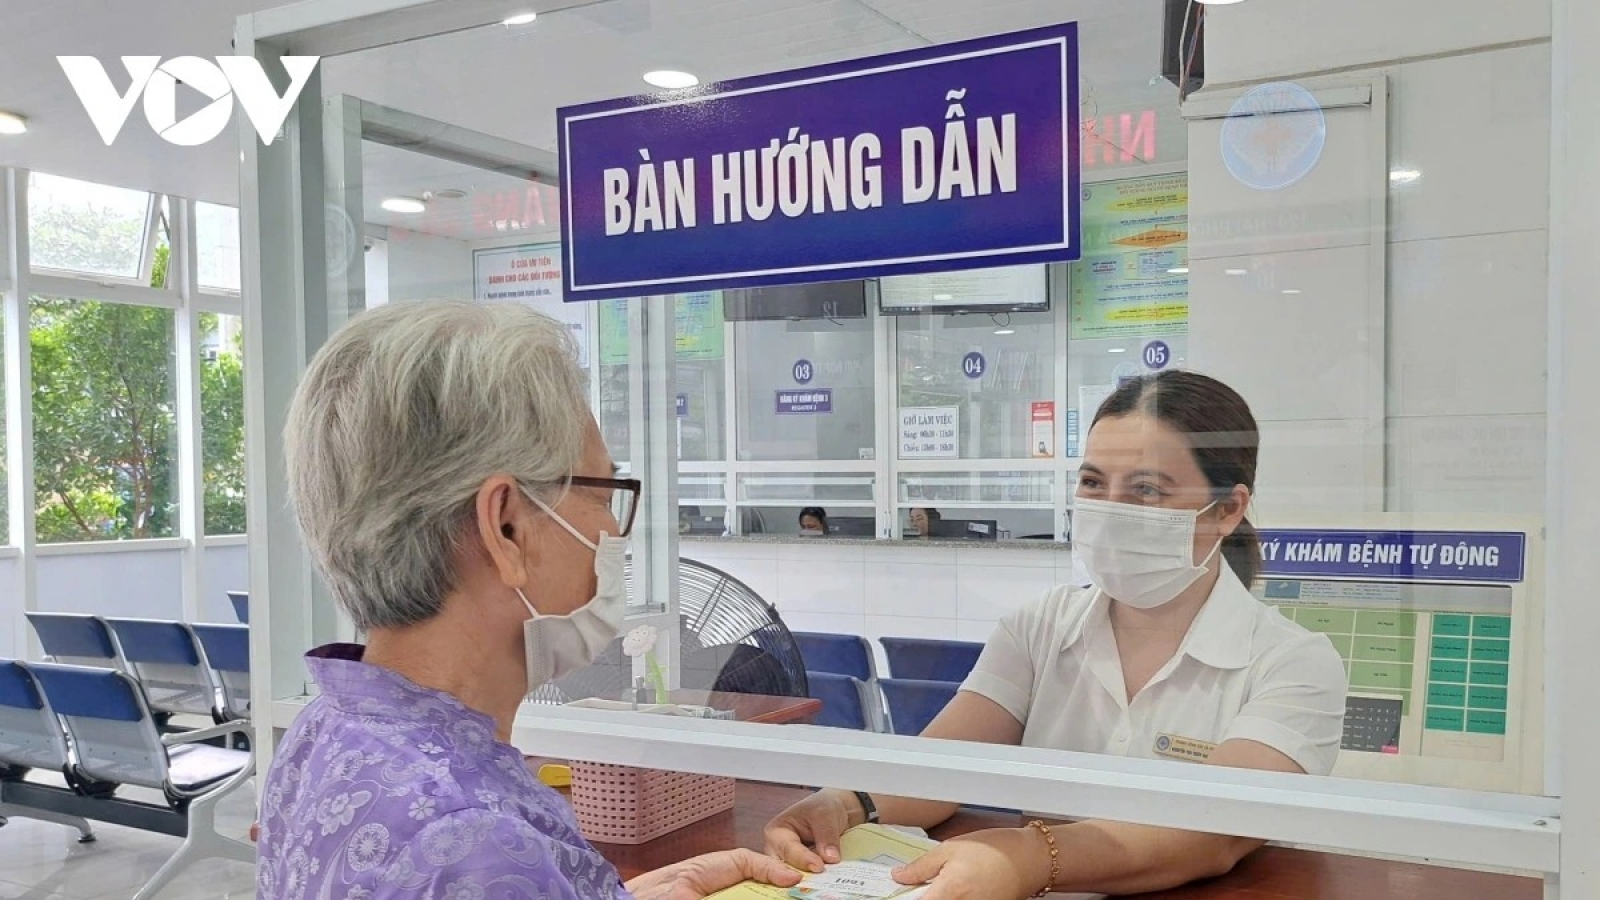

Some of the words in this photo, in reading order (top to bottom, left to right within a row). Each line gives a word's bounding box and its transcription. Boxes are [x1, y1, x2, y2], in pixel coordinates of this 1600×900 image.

[604, 148, 696, 237] BÀN
[712, 127, 882, 226] HƯỚNG
[901, 88, 1018, 205] DẪN
[1146, 346, 1165, 364] 05
[795, 364, 810, 380] 03
[965, 357, 981, 373] 04
[904, 414, 917, 425] GIỜ
[918, 413, 934, 425] LÀM
[935, 413, 953, 425] VIỆC
[1258, 538, 1281, 561] KÝ
[1284, 538, 1343, 563] KHÁM
[1348, 539, 1403, 568] BỆNH
[1409, 543, 1437, 569] TỰ
[1440, 541, 1500, 570] ĐỘNG
